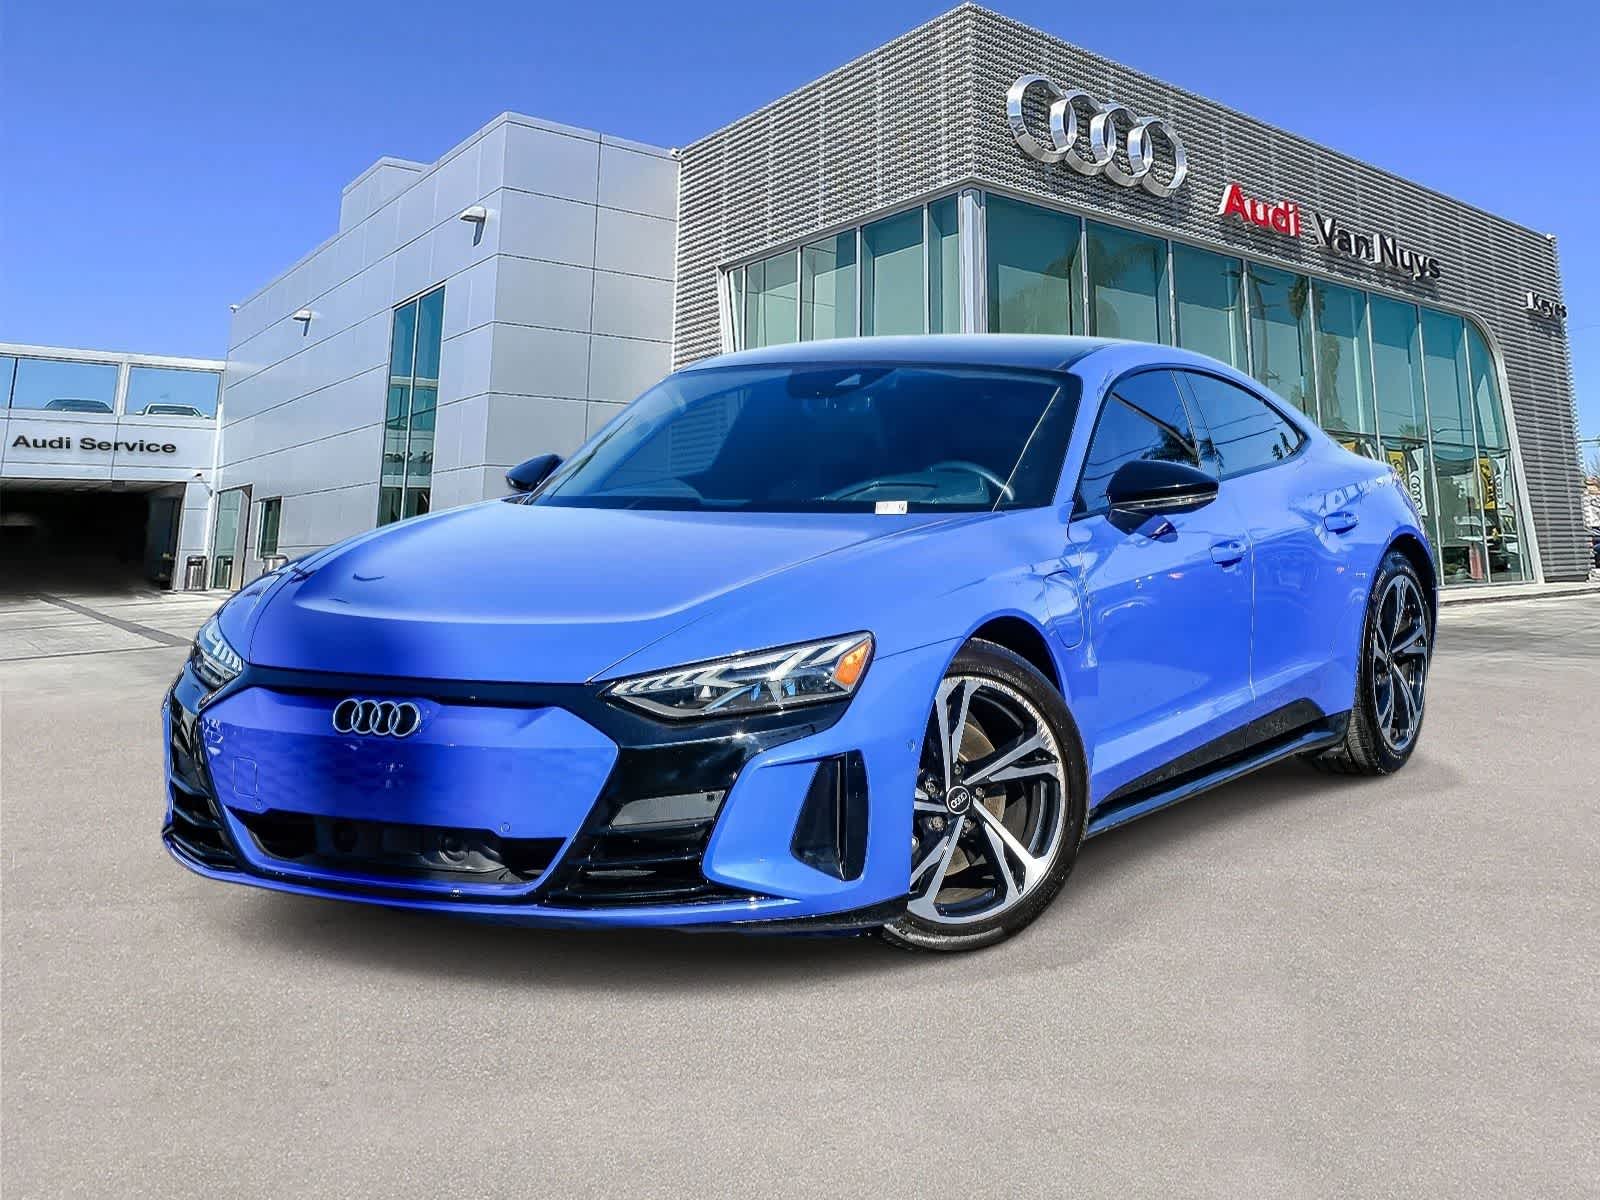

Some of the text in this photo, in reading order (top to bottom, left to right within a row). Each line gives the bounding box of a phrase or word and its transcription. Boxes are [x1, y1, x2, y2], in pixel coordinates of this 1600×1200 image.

[1217, 183, 1441, 281] Audi Van Nuys
[12, 435, 177, 454] Audi Service
